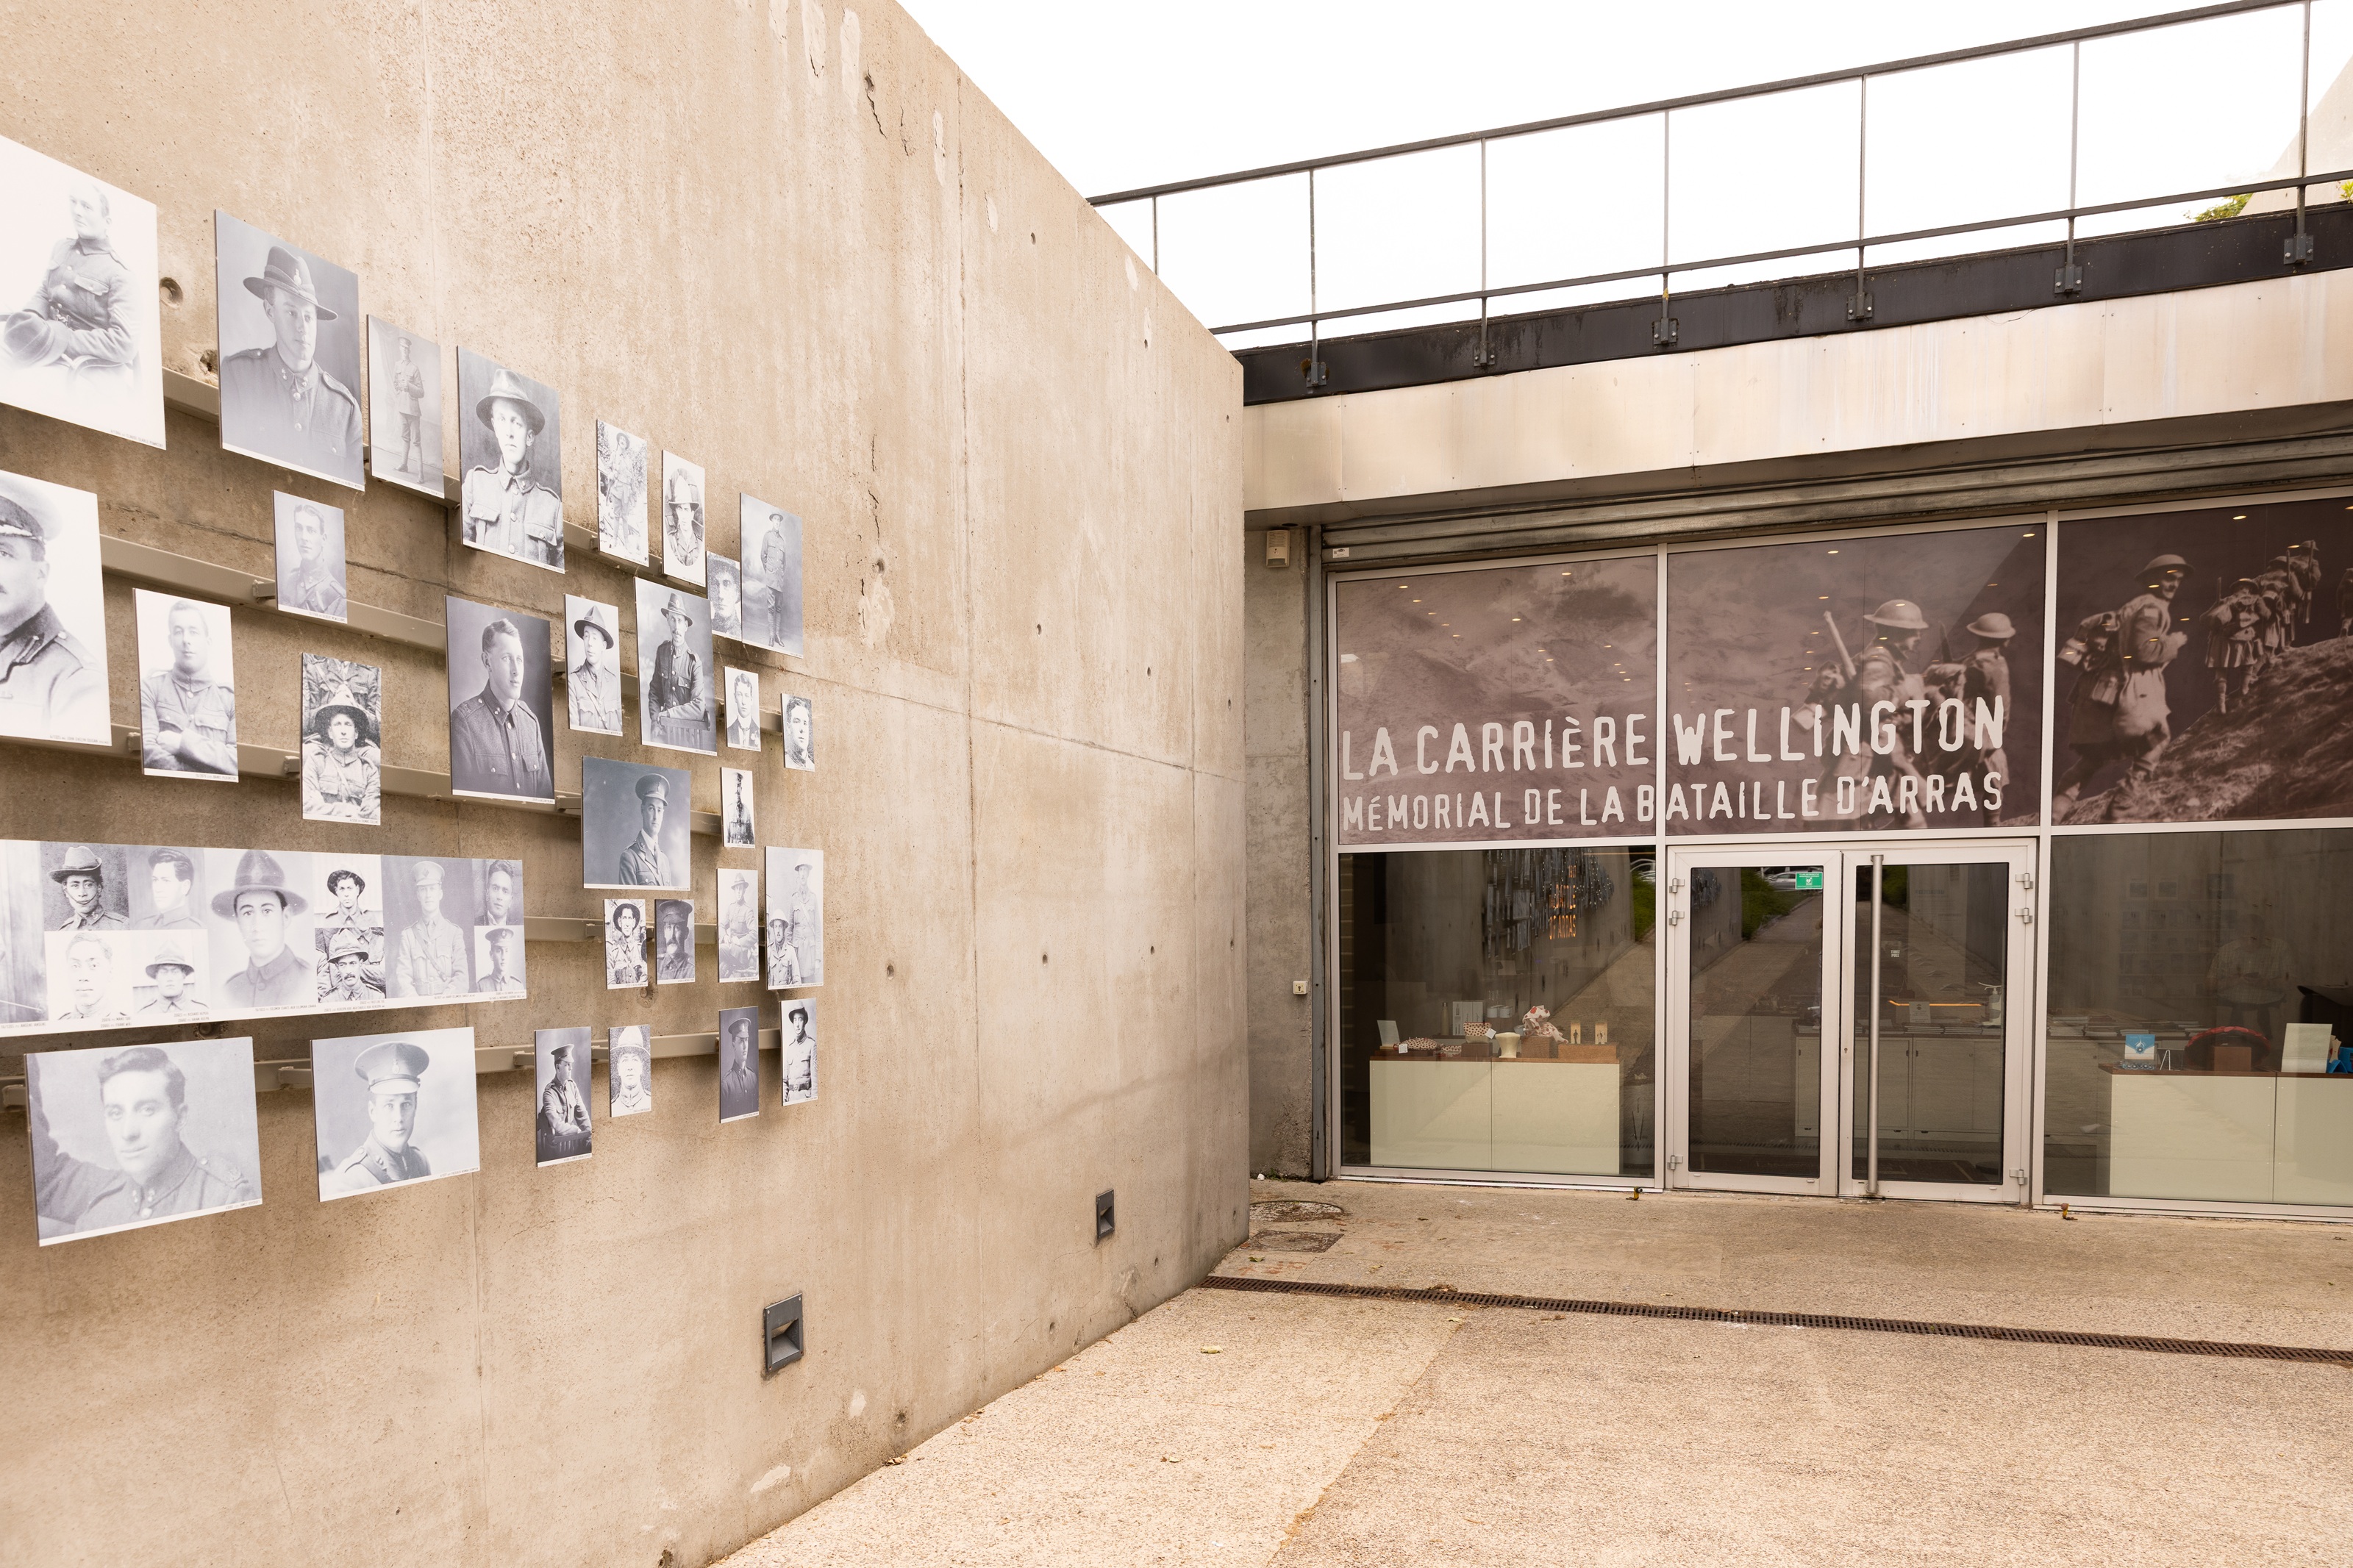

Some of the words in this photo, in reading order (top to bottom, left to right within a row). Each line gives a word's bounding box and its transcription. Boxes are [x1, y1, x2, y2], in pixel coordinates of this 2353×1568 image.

[1342, 726, 1399, 780] LA
[1416, 713, 1650, 774] CARRIÈRE
[1673, 695, 2004, 765] WELLINGTON
[1343, 791, 1511, 831] MÉMORIAL
[1524, 788, 1564, 825] DE
[1580, 786, 1625, 826] LA
[1637, 778, 1819, 822] BATAILLE
[1837, 771, 2002, 815] D'ARRAS
